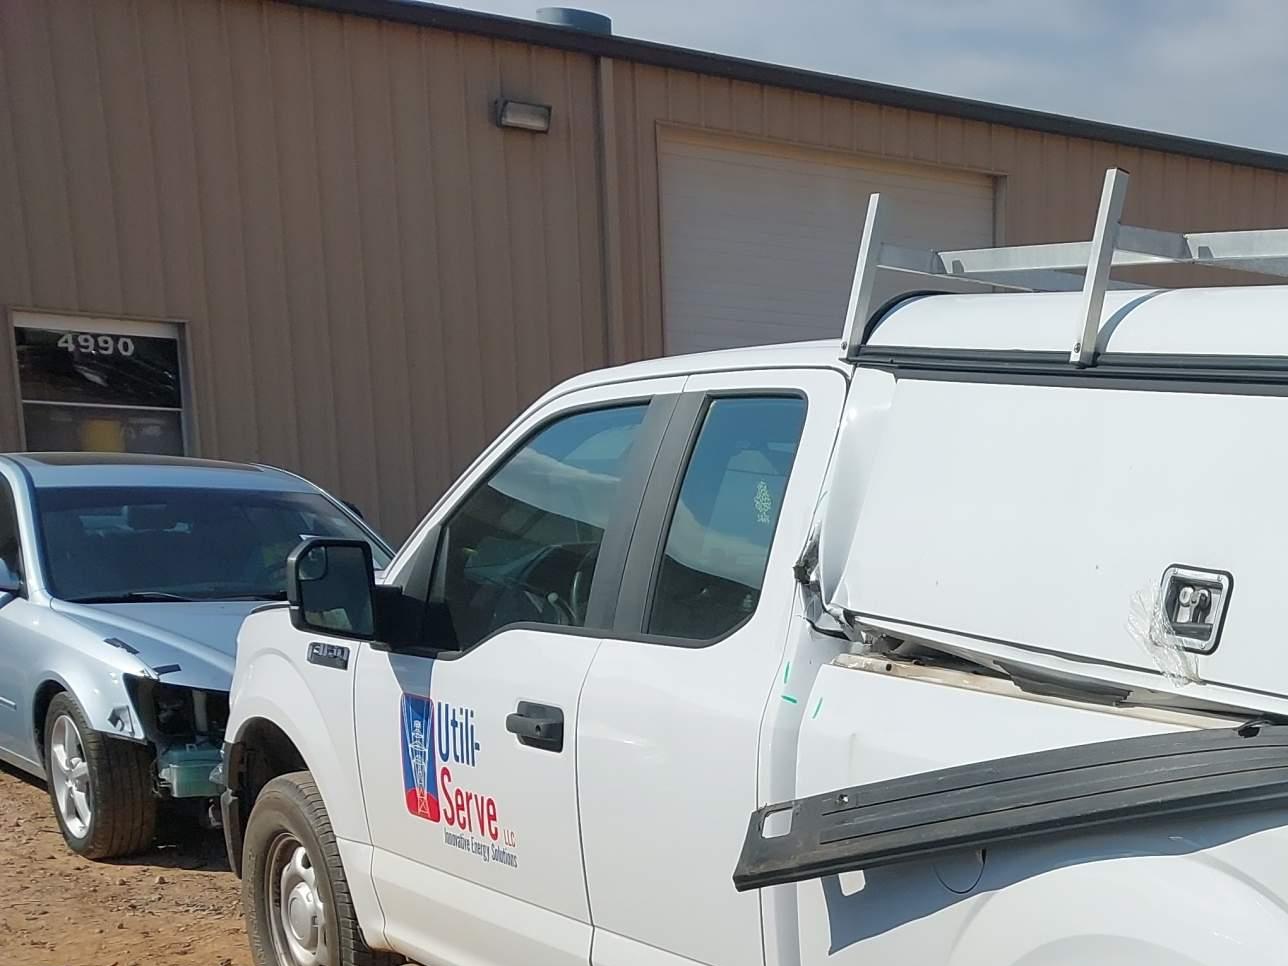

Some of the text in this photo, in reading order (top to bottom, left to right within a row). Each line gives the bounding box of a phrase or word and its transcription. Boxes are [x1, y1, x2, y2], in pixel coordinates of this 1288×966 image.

[57, 333, 135, 356] 4990
[438, 702, 480, 767] Utili-
[441, 767, 516, 848] Serve LLC
[444, 827, 518, 868] Innovative Energy Solutions
